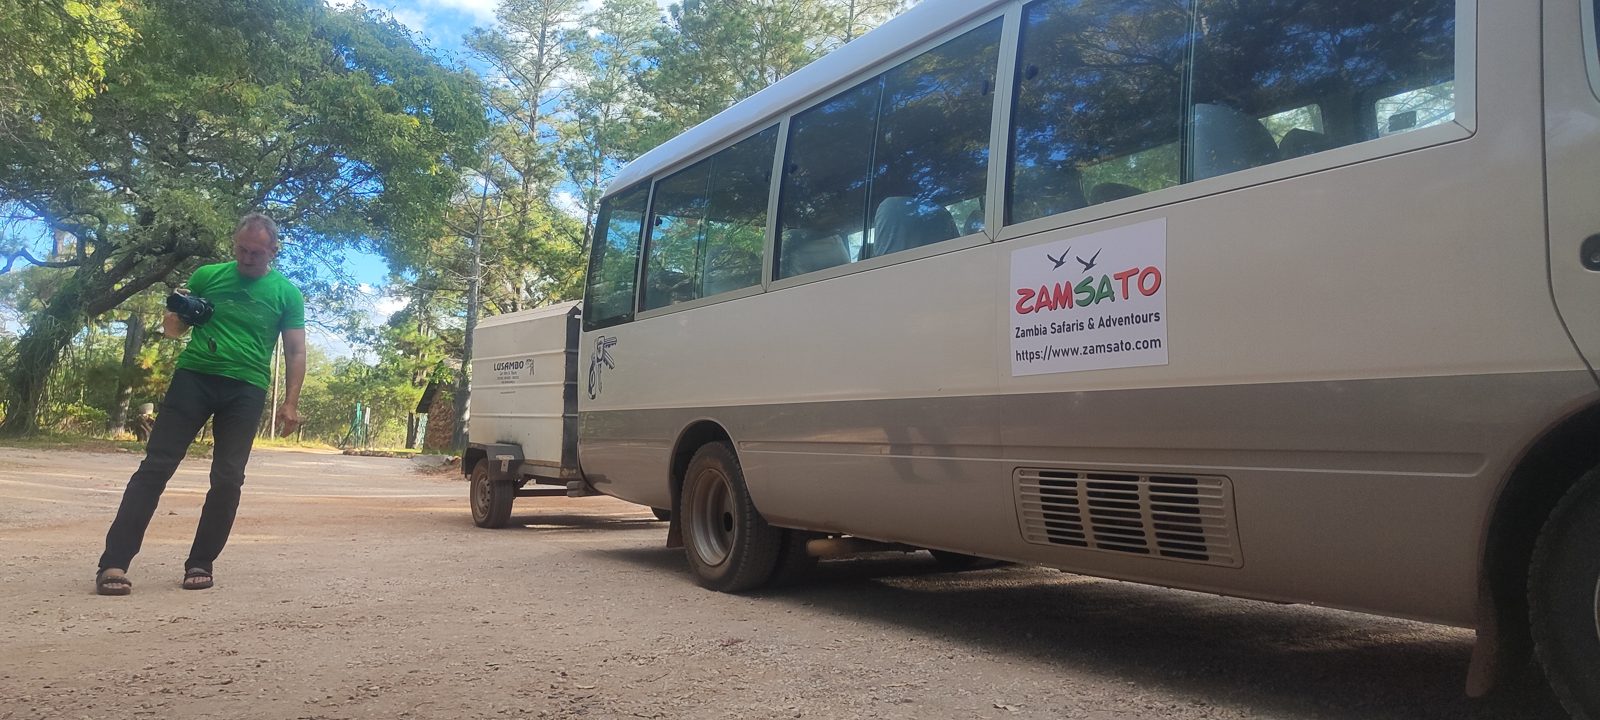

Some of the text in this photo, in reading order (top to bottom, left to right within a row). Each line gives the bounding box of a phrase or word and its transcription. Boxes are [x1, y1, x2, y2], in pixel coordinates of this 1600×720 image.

[1015, 266, 1162, 314] ZAMSATO
[1015, 311, 1161, 339] Zambia Safaris & Adventours
[1015, 338, 1162, 363] https://www.zamsato.com
[493, 360, 524, 371] LUSAMBO
